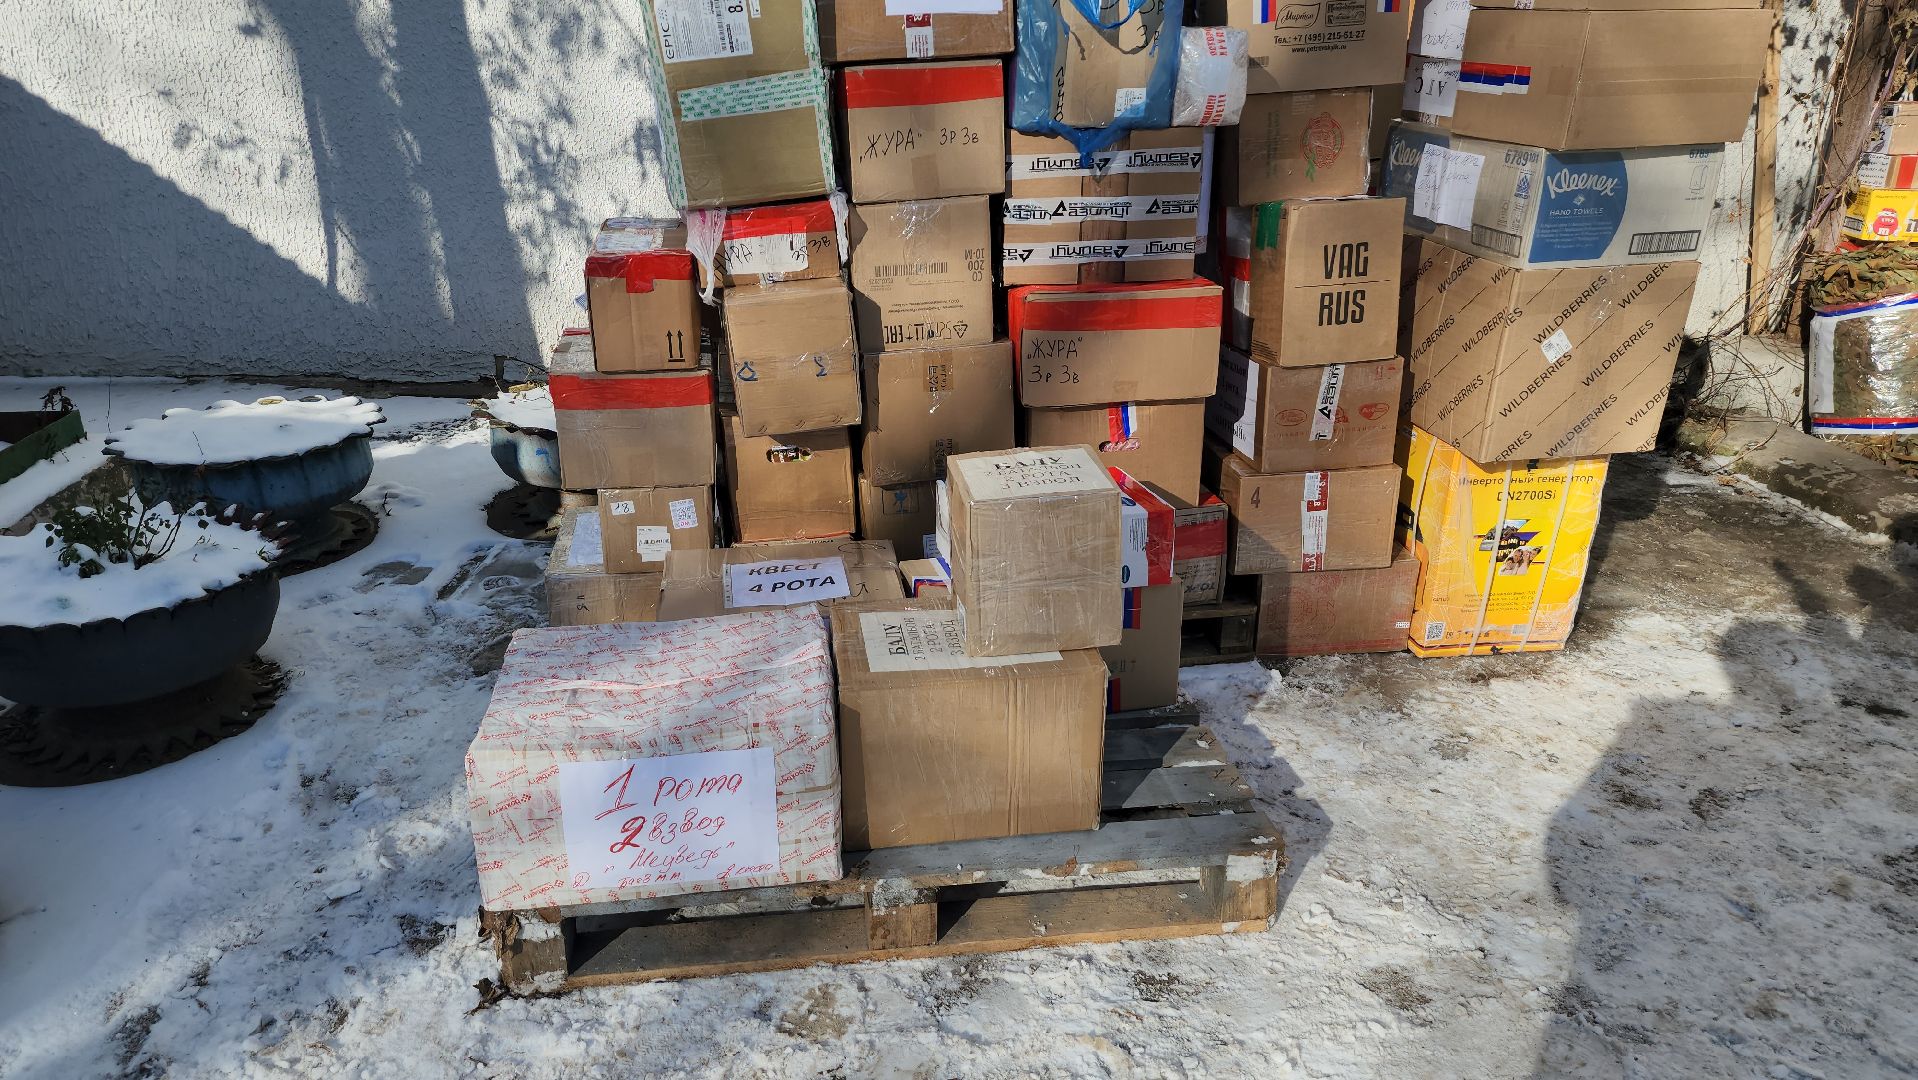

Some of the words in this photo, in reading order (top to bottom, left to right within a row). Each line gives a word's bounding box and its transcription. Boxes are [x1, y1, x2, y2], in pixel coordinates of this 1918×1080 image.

[1391, 140, 1421, 170] Kleen
[1547, 168, 1618, 199] Kleenex
[1322, 242, 1369, 280] VAG
[1437, 255, 1476, 294] WILDBER
[1617, 263, 1670, 310] WILDBER
[1318, 290, 1366, 326] RUS
[1533, 275, 1608, 345] WILDBERRIES
[1410, 314, 1455, 363] WILDBERRIES
[1582, 319, 1655, 388] WILDBERRIES
[1437, 376, 1484, 421] WILDBERRIES
[1499, 352, 1573, 419] WILDBERRIES
[1626, 383, 1671, 428] WILDBER
[1545, 394, 1618, 459] WILDBERRIES
[1494, 430, 1533, 463] ERRIES
[1251, 487, 1261, 508] 4
[1459, 475, 1535, 486] Инвертоный
[1537, 475, 1594, 485] генертор
[749, 562, 823, 575] КВЕСТ
[749, 583, 763, 593] 4
[771, 576, 836, 593] РОТА
[653, 773, 743, 806] рота
[609, 815, 647, 854] 2
